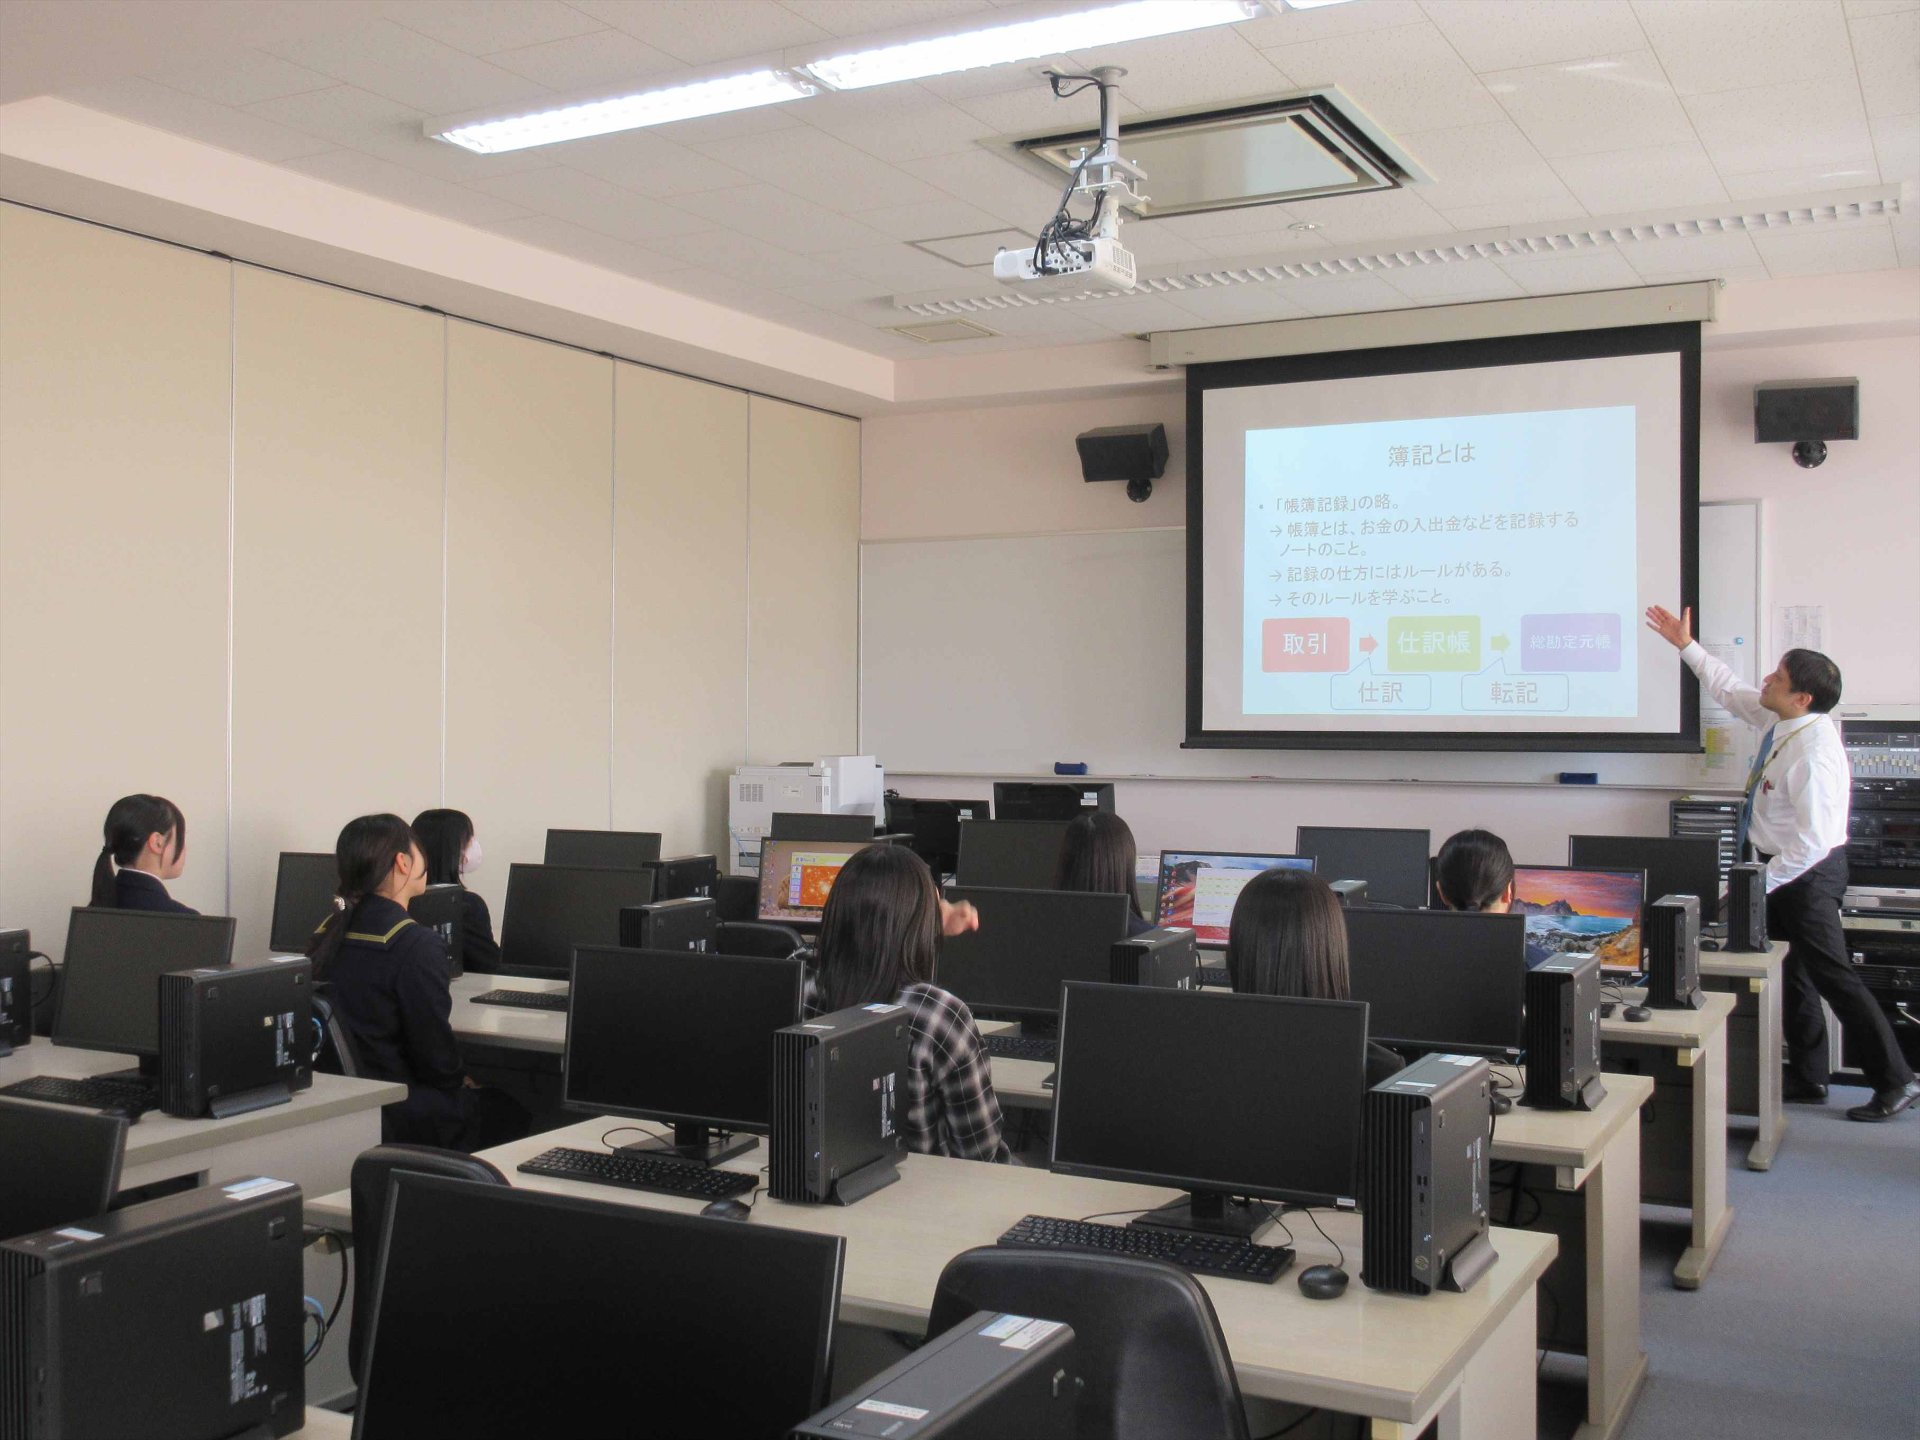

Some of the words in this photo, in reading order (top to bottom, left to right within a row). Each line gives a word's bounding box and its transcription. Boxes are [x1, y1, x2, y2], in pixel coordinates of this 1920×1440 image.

[1387, 442, 1477, 468] 簿記とは
[1286, 511, 1580, 537] 帳簿とは、お金の入出金などを記録する
[1279, 541, 1369, 557] ノートのこと。
[1287, 562, 1512, 583] 記録の仕方にはルールがある。
[1287, 588, 1452, 607] そのルールを学ぶこと。
[1283, 633, 1328, 656] 取引
[1397, 631, 1472, 656] 仕訳帳
[1530, 633, 1613, 651] 総勘定元帳
[1358, 681, 1404, 704] 仕訳
[1490, 681, 1539, 704] 転記
